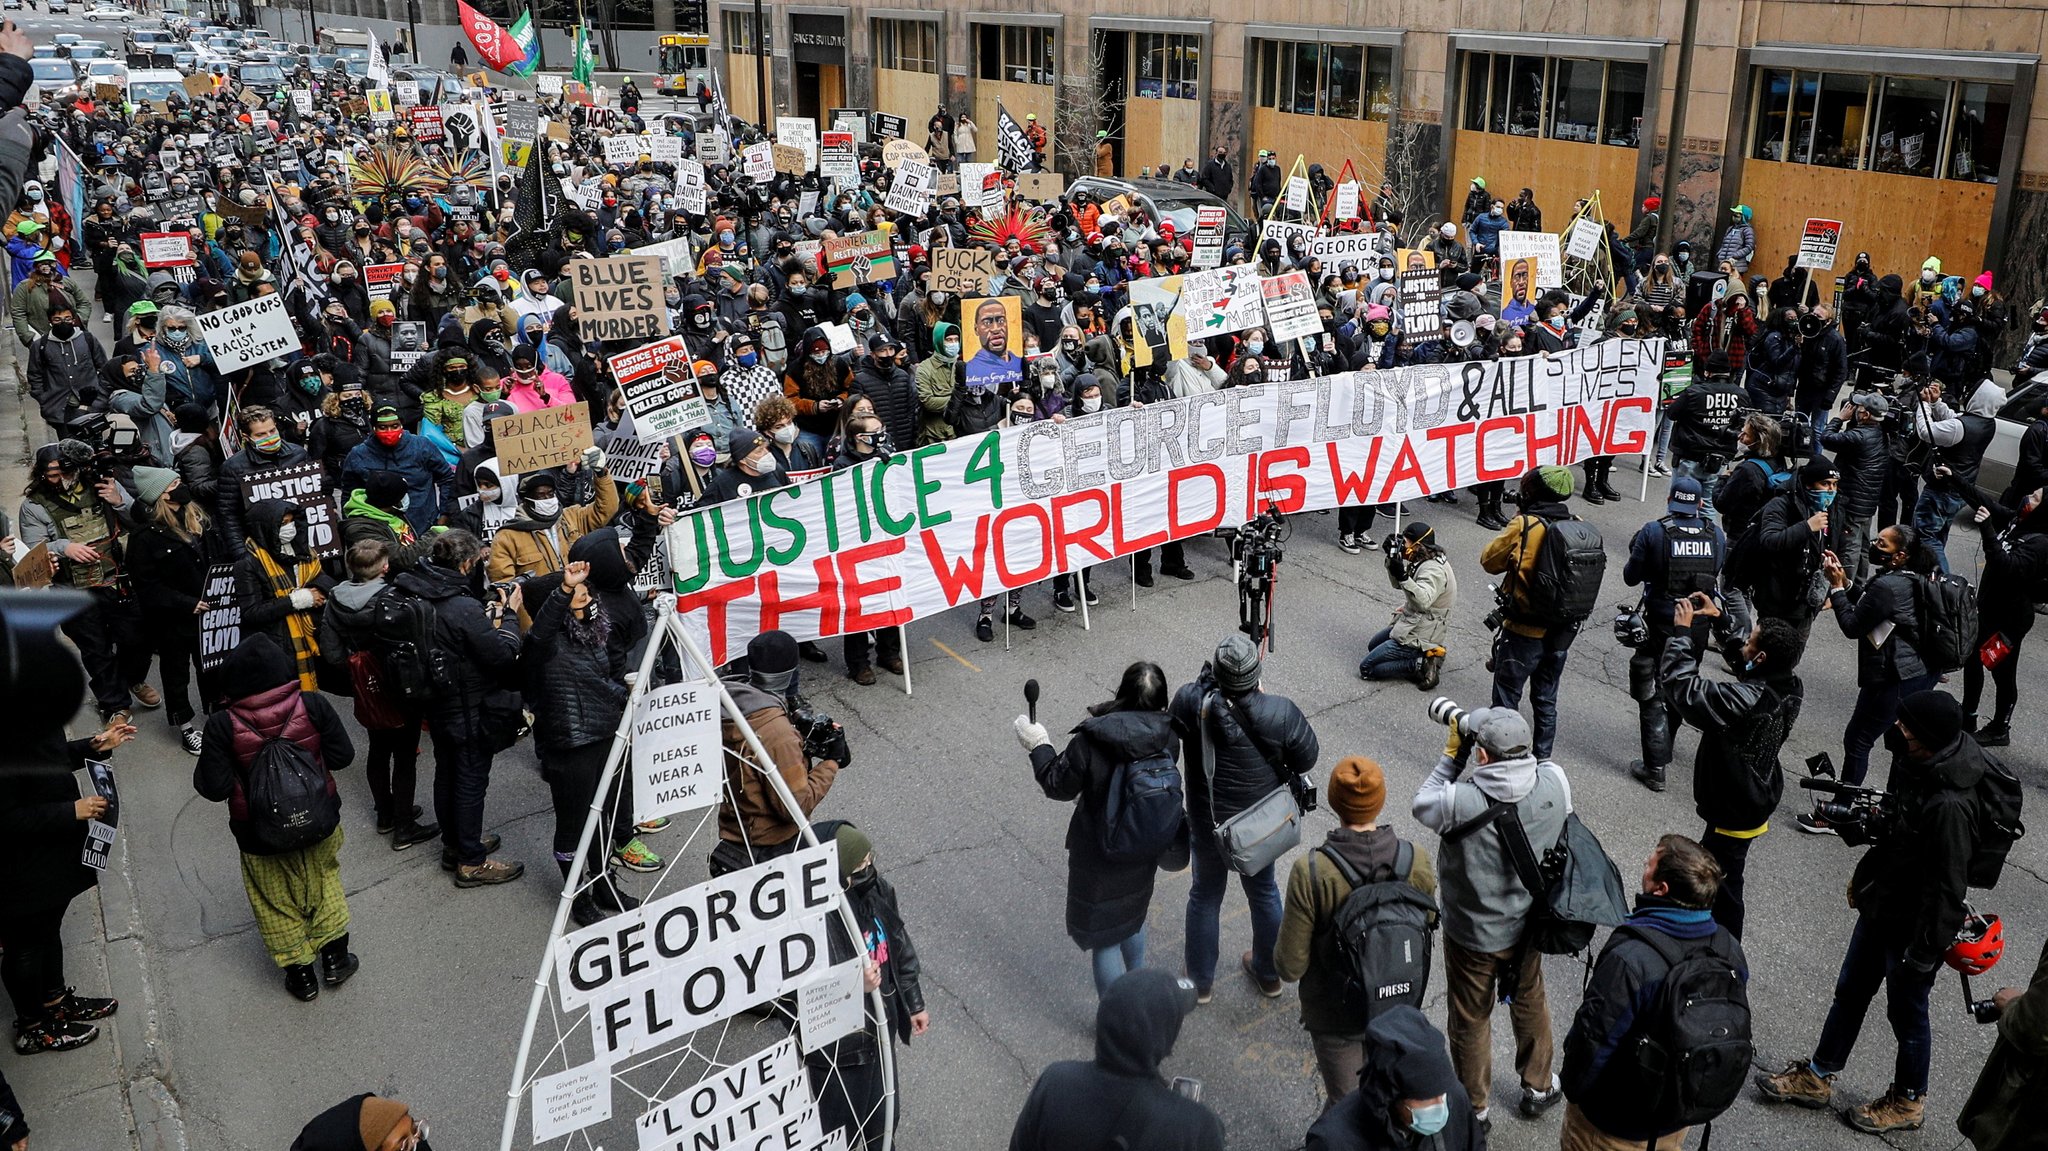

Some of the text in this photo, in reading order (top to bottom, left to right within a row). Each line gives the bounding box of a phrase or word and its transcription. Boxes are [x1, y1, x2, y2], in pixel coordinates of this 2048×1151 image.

[413, 110, 440, 118] JUSTICE
[586, 108, 615, 129] ACAB
[883, 116, 900, 126] BLACK
[511, 121, 534, 130] BLACK
[884, 123, 898, 131] LIVES
[891, 142, 910, 150] YOUR
[999, 113, 1035, 161] BLACK
[744, 144, 769, 156] JUSTICE
[752, 153, 762, 162] FOR
[885, 152, 900, 161] COP
[680, 160, 704, 173] JUSTICE
[746, 162, 772, 174] DAUNTE
[900, 159, 931, 178] JUSTICE
[966, 163, 989, 173] STOP
[687, 175, 698, 185] FOR
[906, 175, 919, 186] FOR
[937, 184, 955, 192] NOW
[676, 185, 704, 200] DAUNTE
[891, 185, 924, 202] DAUNTE
[587, 200, 599, 208] FOR
[674, 196, 704, 212] WRIGHT
[887, 195, 920, 214] WRIGHT
[1528, 235, 1554, 243] NEGRO
[1577, 227, 1599, 237] VACCINATE
[833, 250, 851, 259] REST
[1314, 237, 1378, 255] GEORGE
[1530, 244, 1556, 252] COUNTRY
[936, 249, 989, 275] FUCK
[579, 261, 649, 286] BLUE
[369, 283, 391, 291] JUSTICE
[1403, 277, 1439, 293] JUSTICE
[580, 285, 654, 312] LIVES
[1416, 292, 1426, 300] FOR
[199, 297, 281, 331] NO GOOD COPS
[1295, 306, 1315, 316] FLOYD
[1404, 300, 1440, 316] GEORGE
[230, 322, 257, 337] IN A
[582, 314, 661, 340] MURDER
[1404, 315, 1440, 334] FLOYD
[211, 334, 255, 357] RACIST
[239, 337, 289, 362] SYSTEM
[615, 344, 671, 369] JUSTICE FOR
[617, 349, 684, 378] GEORGE FLOYD
[1547, 338, 1658, 377] STOLEN
[627, 376, 667, 397] CONVICT
[1563, 369, 1637, 405] LIVES
[632, 385, 694, 415] KILLER COPS
[1706, 393, 1739, 409] DEUS
[503, 412, 566, 437] BLACK
[649, 408, 681, 424] CHAUVIN,
[654, 417, 678, 431] KEUNG
[685, 408, 706, 420] THAO
[520, 431, 573, 454] LIVES
[507, 447, 580, 475] MATTER
[673, 359, 1547, 594] JUSTICE 4 GEORGE FLOYD & ALL
[248, 474, 322, 503] JUSTICE
[1674, 491, 1696, 501] PRESS
[676, 396, 1652, 668] THE WORLD IS WATCHING
[1674, 541, 1712, 556] MEDIA
[202, 626, 241, 656] FLOYD
[649, 691, 697, 711] PLEASE
[637, 709, 712, 736] VACCINATE
[653, 744, 698, 765] PLEASE
[649, 763, 703, 786] WEAR A
[656, 784, 697, 805] MASK
[91, 823, 114, 842] JUSTICE
[83, 850, 106, 869] FLOYD
[569, 858, 830, 991] GEORGE
[604, 933, 816, 1052] FLOYD
[805, 980, 841, 996] ARTIST JOE
[1379, 982, 1410, 999] PRESS
[806, 993, 827, 1006] GEARY
[807, 997, 842, 1015] TEAR DROP
[807, 1010, 831, 1024] DREAM
[809, 1017, 837, 1033] CATCHER
[556, 1074, 589, 1090] Given by
[548, 1093, 597, 1114] Great Auntie
[552, 1113, 570, 1124] Mel,
[580, 1105, 593, 1114] Joe
